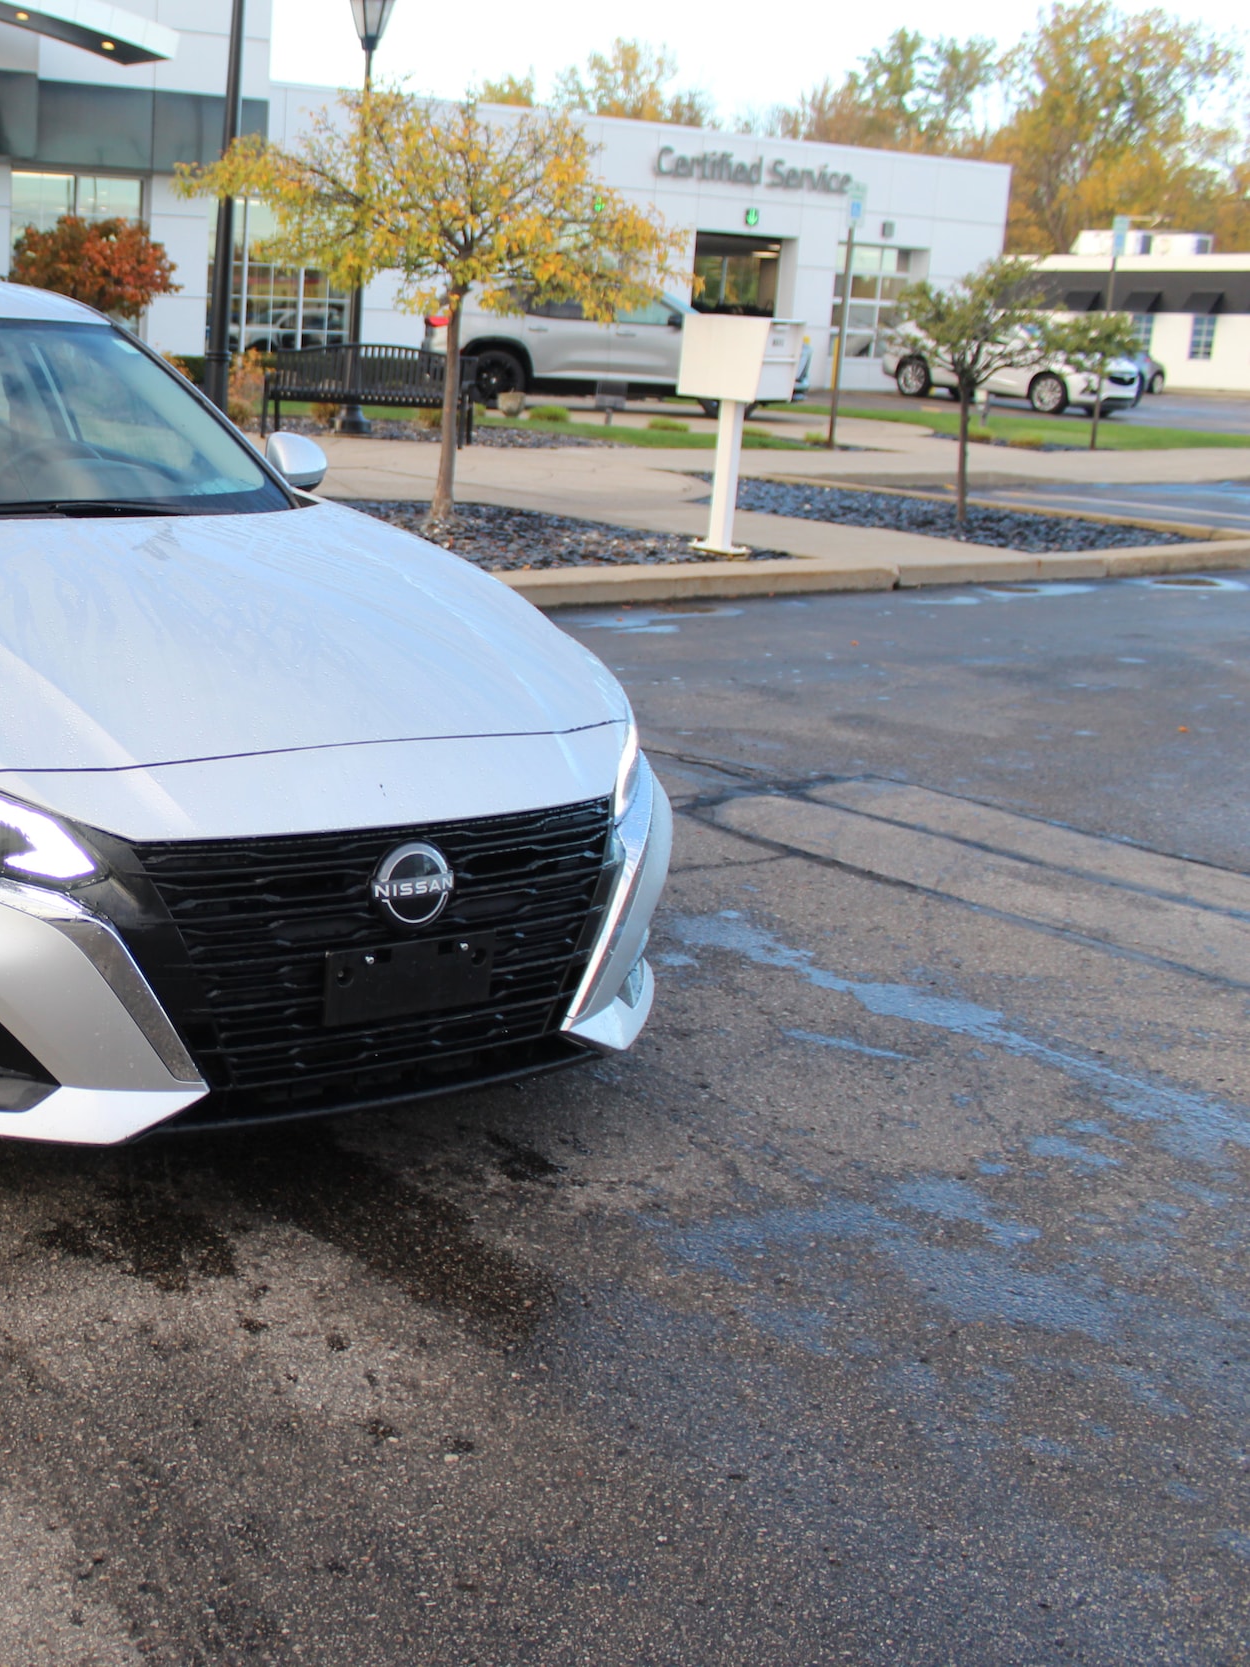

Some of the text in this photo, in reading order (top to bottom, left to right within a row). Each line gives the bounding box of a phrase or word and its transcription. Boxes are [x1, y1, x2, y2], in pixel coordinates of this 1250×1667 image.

[654, 146, 763, 185] Certified
[767, 159, 853, 193] Service
[374, 876, 454, 898] NISSAN
